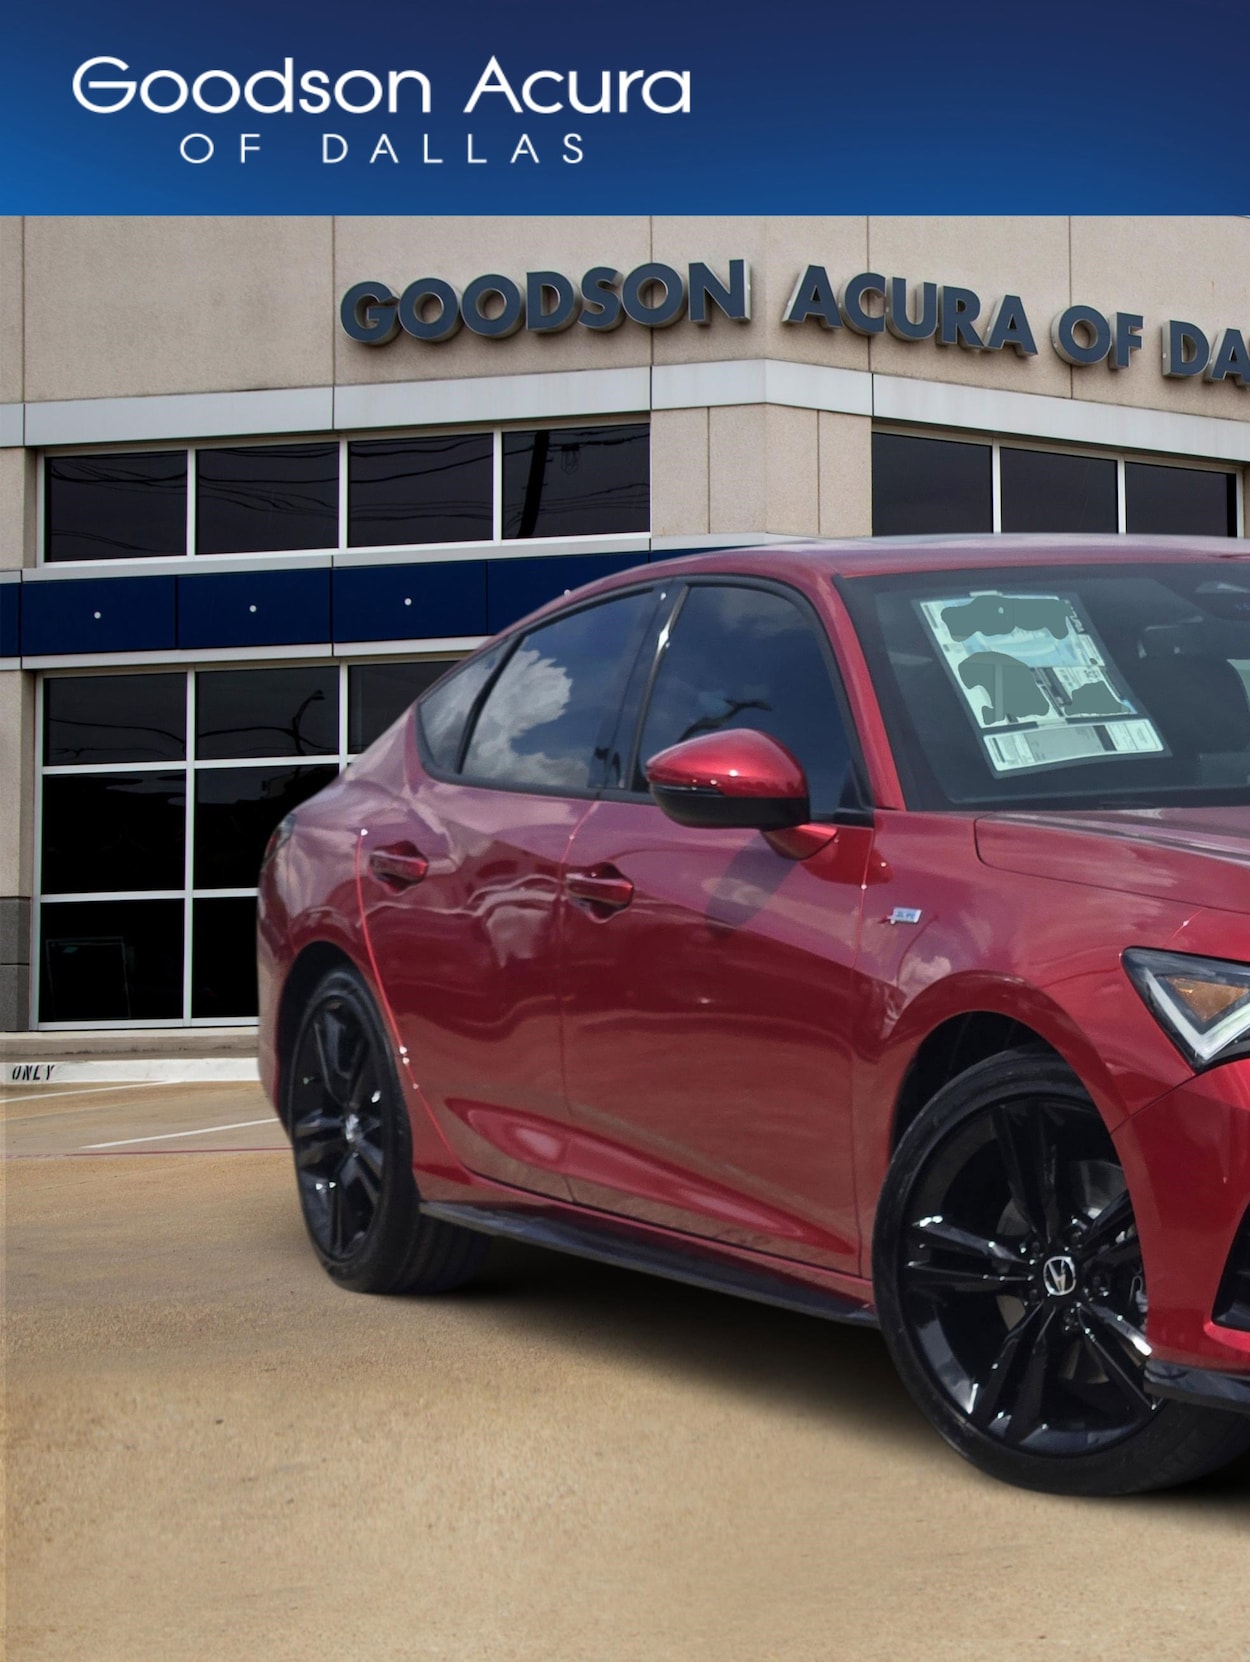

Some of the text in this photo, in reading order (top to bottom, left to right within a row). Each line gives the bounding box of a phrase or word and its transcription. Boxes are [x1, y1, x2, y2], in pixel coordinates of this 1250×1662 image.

[339, 258, 752, 345] GOODSON
[782, 264, 1038, 357] ACURA
[1052, 304, 1144, 370] OF
[12, 1064, 55, 1081] ONLY
